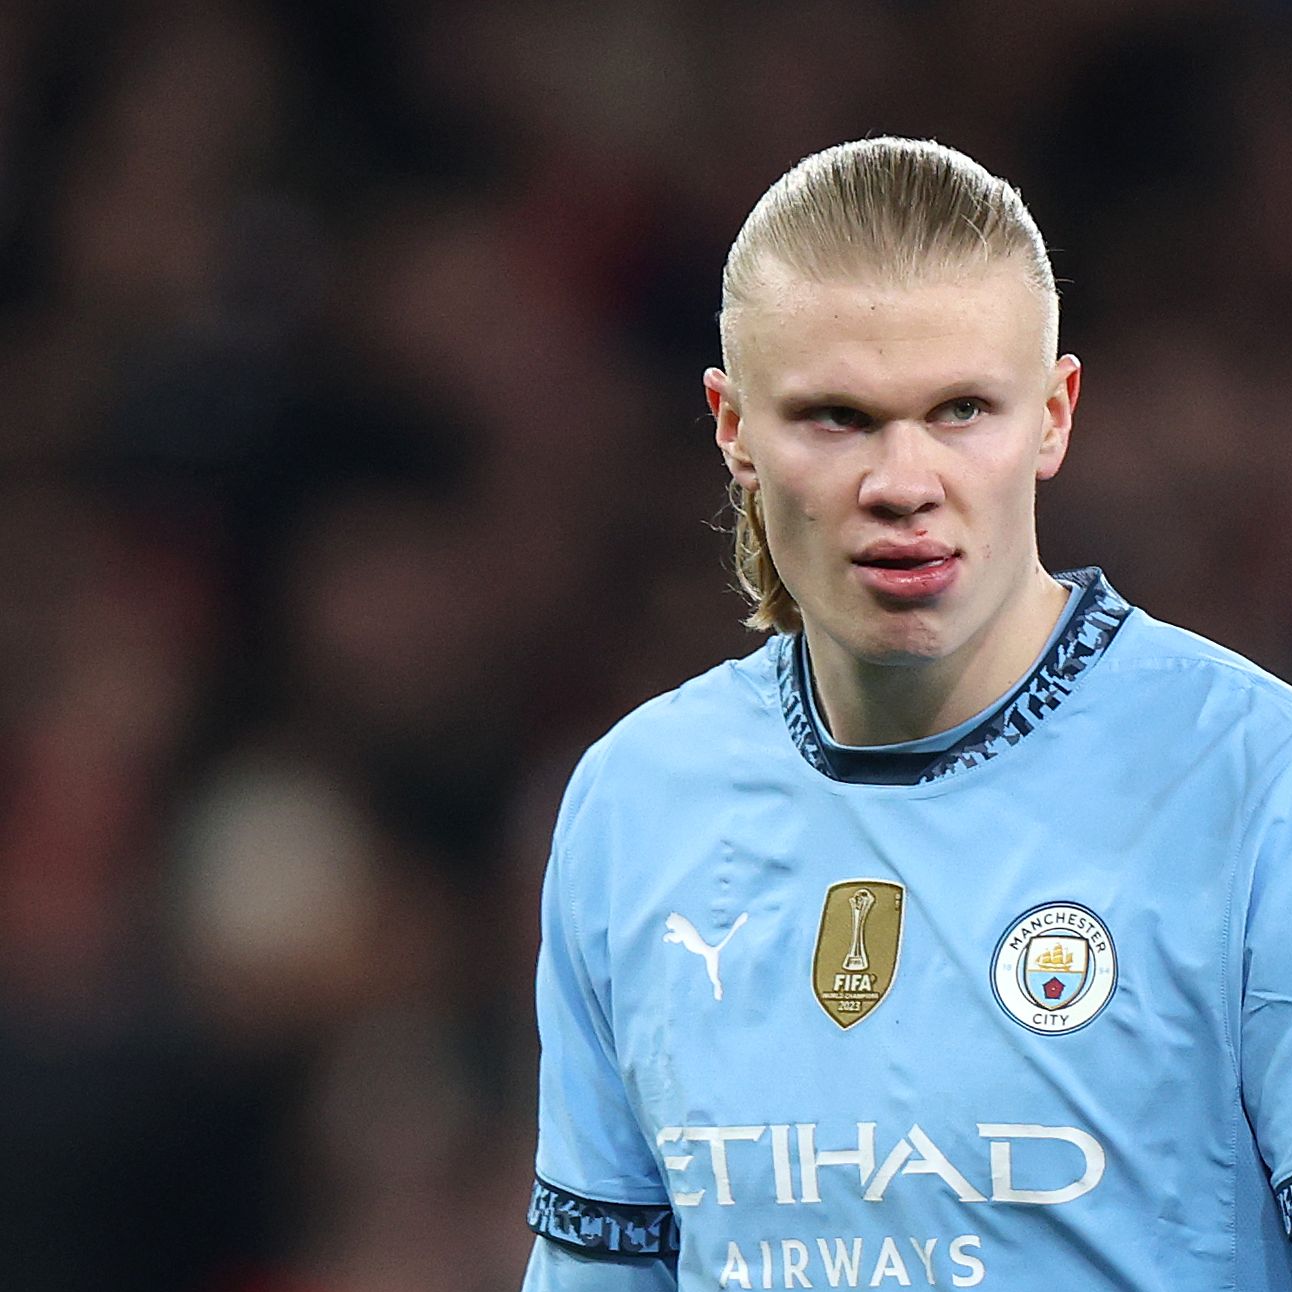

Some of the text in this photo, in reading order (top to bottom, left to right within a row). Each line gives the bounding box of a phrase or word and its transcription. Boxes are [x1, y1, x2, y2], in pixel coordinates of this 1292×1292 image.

[1009, 911, 1107, 954] MANCHESTER
[833, 973, 872, 992] FIFA
[1032, 1013, 1069, 1026] CITY
[655, 1122, 1106, 1206] ETIHAD
[720, 1234, 987, 1290] AIRWAYS
